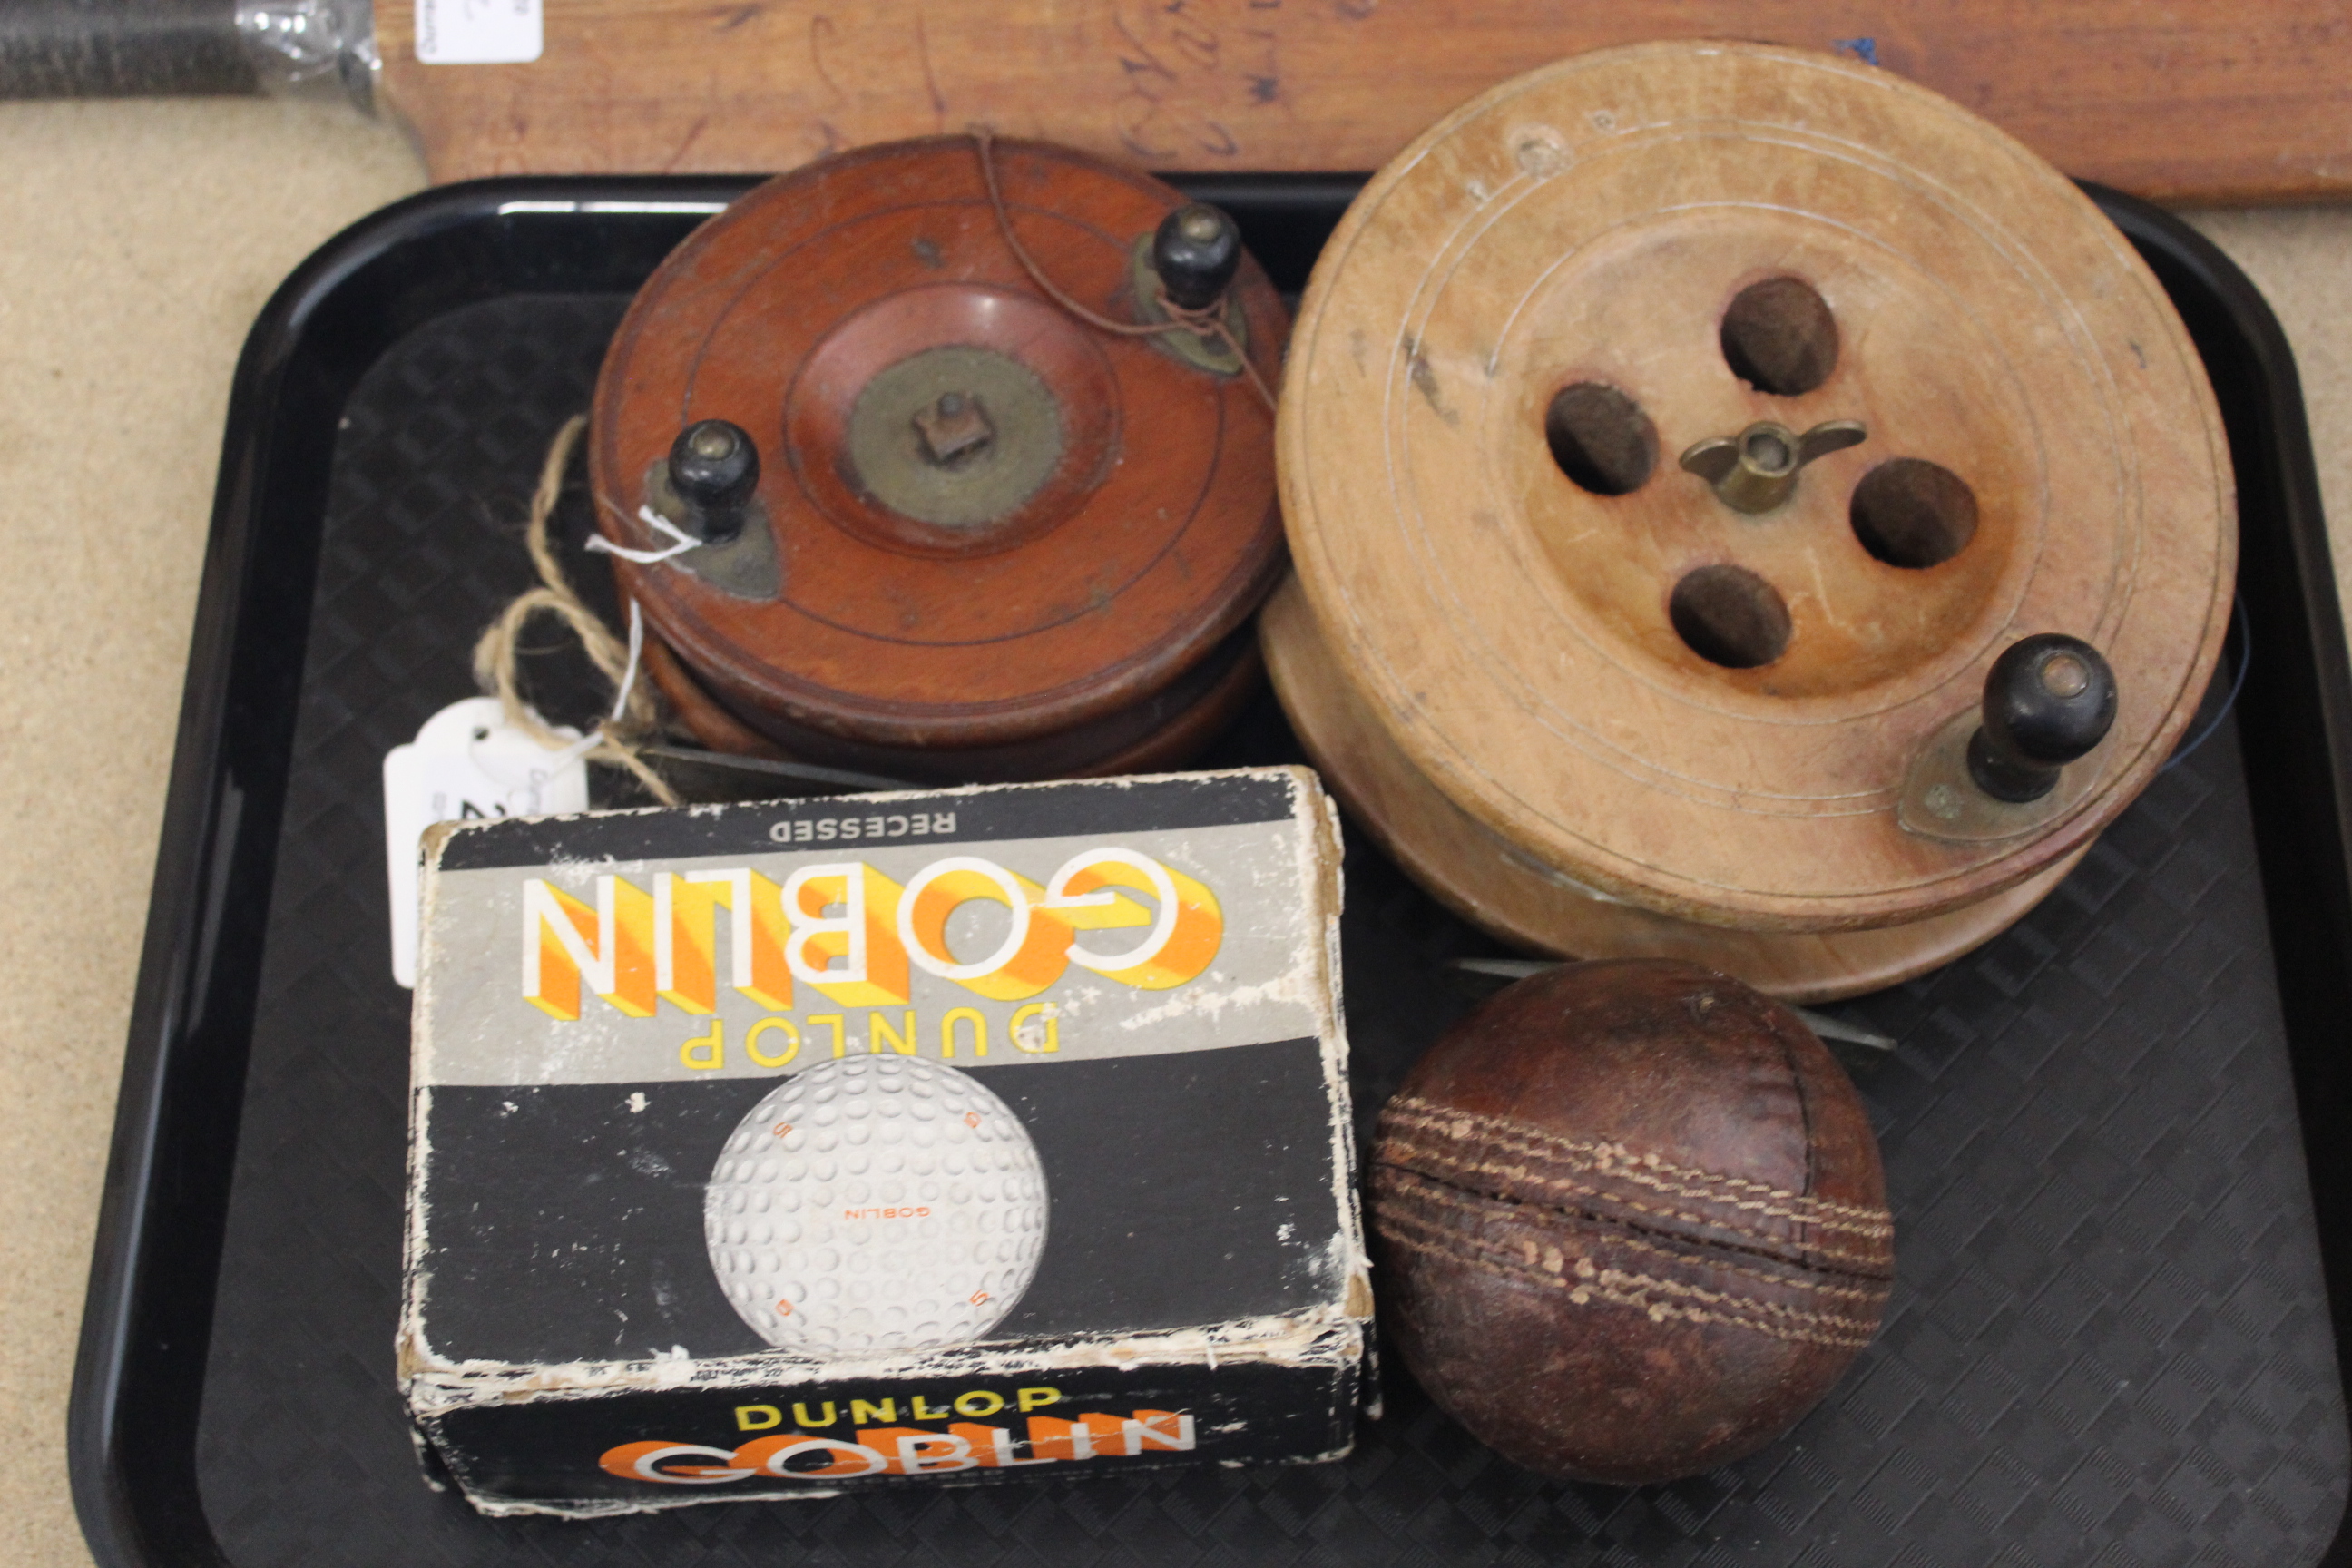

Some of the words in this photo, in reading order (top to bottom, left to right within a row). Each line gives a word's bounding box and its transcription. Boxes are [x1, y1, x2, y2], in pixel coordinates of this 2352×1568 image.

[770, 811, 957, 843] RECESSED
[522, 847, 1223, 1021] GOBLIN
[679, 1001, 1060, 1070] DUNLOP
[844, 1206, 932, 1220] GOBLIN
[734, 1387, 1063, 1432] DUNLOP
[599, 1408, 1196, 1485] GOBLIN
